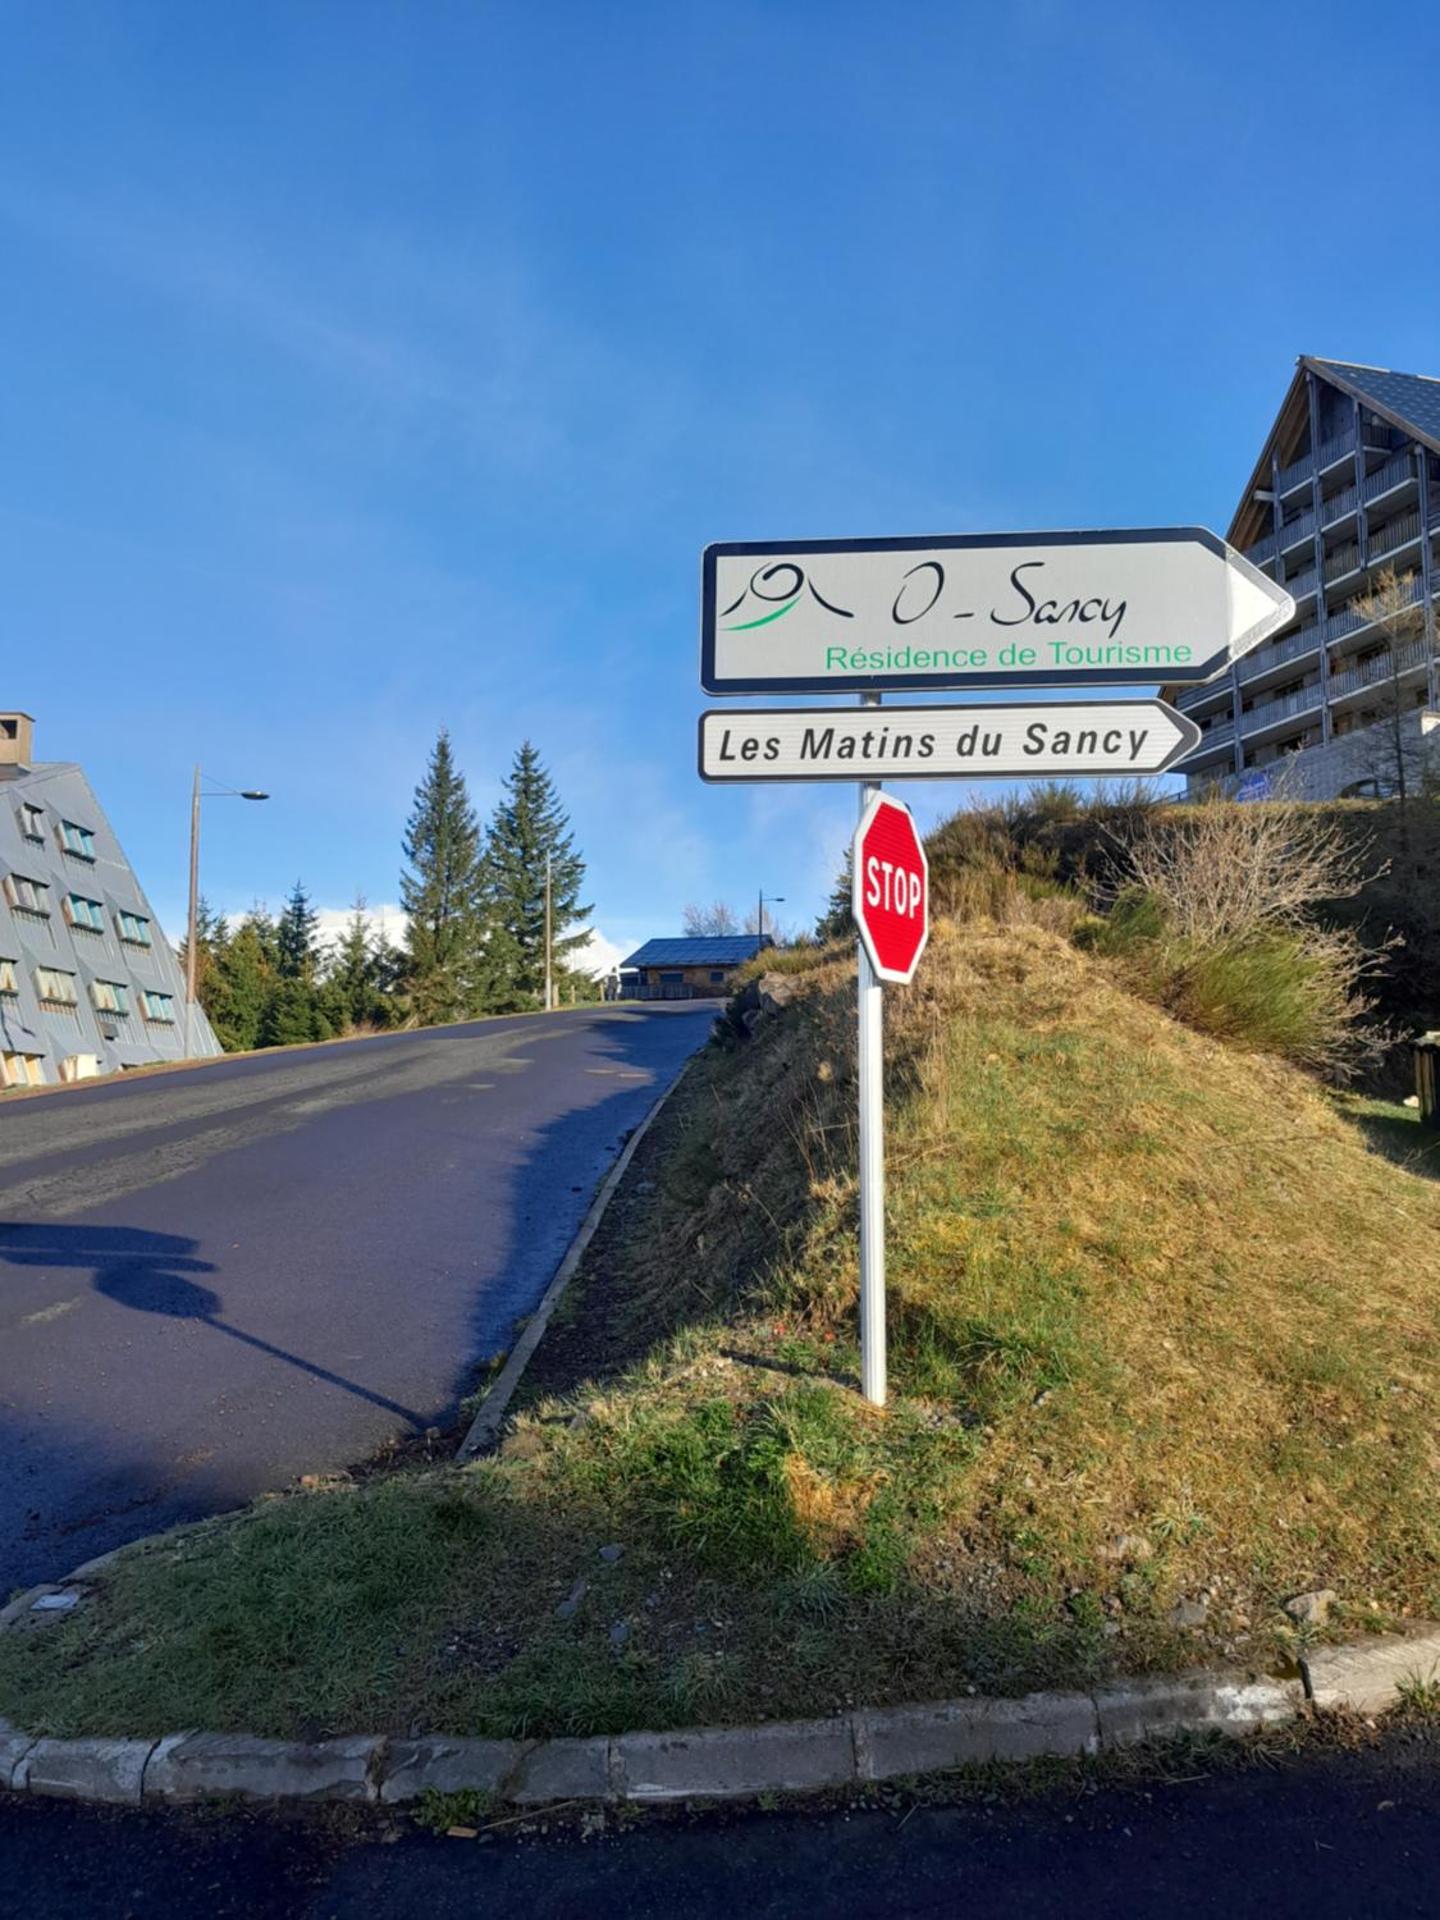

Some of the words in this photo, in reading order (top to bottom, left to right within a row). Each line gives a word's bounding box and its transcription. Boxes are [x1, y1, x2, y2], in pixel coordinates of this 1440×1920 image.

[891, 561, 945, 625] O
[990, 561, 1128, 639] Sancy
[826, 645, 987, 671] Résidence
[998, 644, 1036, 667] de
[1053, 640, 1192, 667] Tourisme
[720, 730, 781, 761] Les
[800, 727, 935, 760] Matins
[957, 725, 1002, 757] du
[1023, 723, 1149, 761] Sancy
[866, 856, 922, 919] STOP
